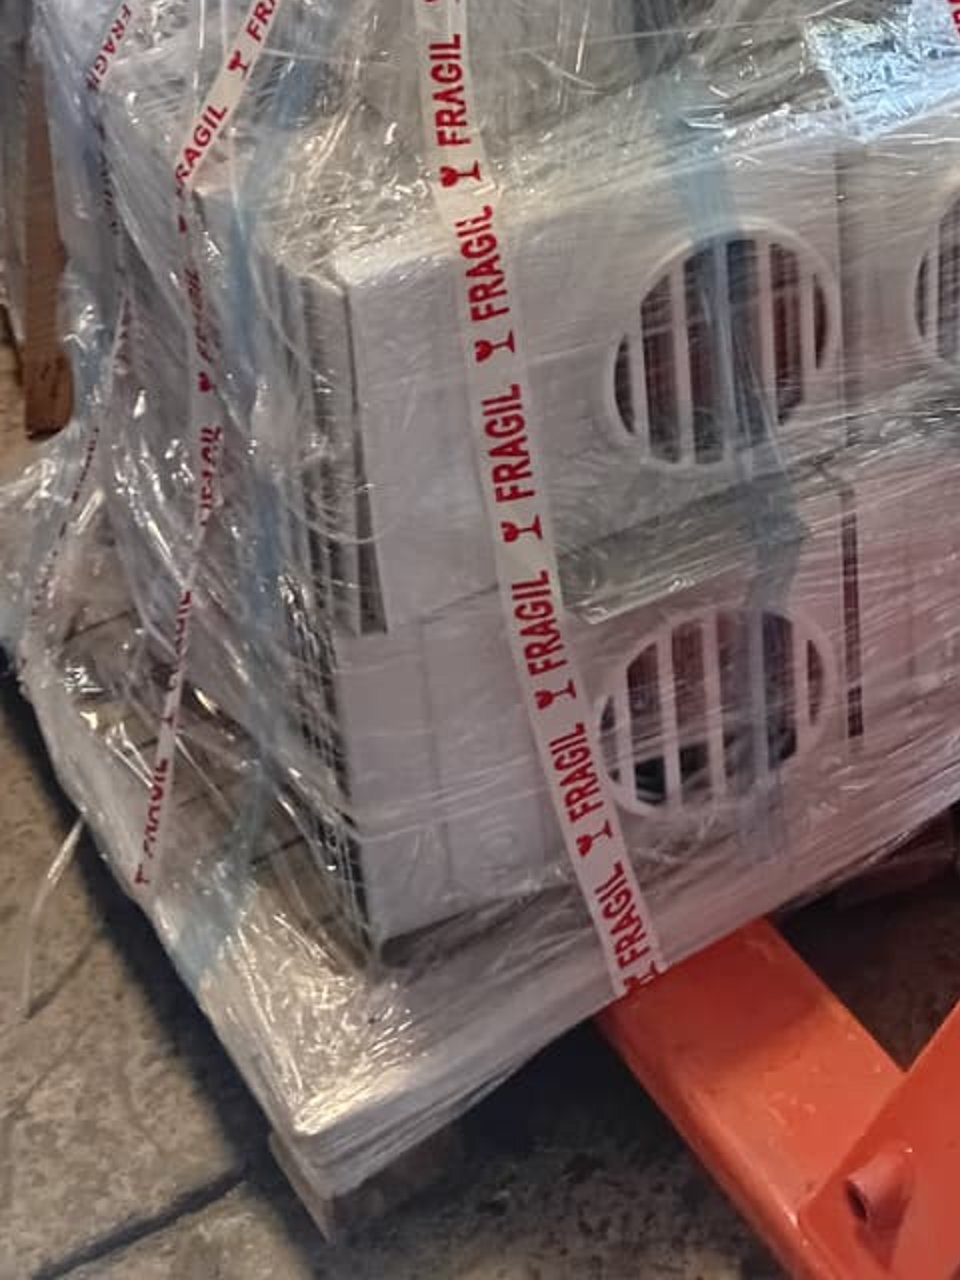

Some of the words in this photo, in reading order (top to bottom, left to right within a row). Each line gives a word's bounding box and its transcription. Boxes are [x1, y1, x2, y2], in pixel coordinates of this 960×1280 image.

[430, 33, 468, 147] FRAGIL
[456, 204, 510, 322] FRAGIL
[483, 383, 537, 503] FRAGIL
[511, 569, 567, 677] FRAGIL
[550, 722, 603, 825] FRAGIL
[595, 863, 648, 971] FRAGIL
